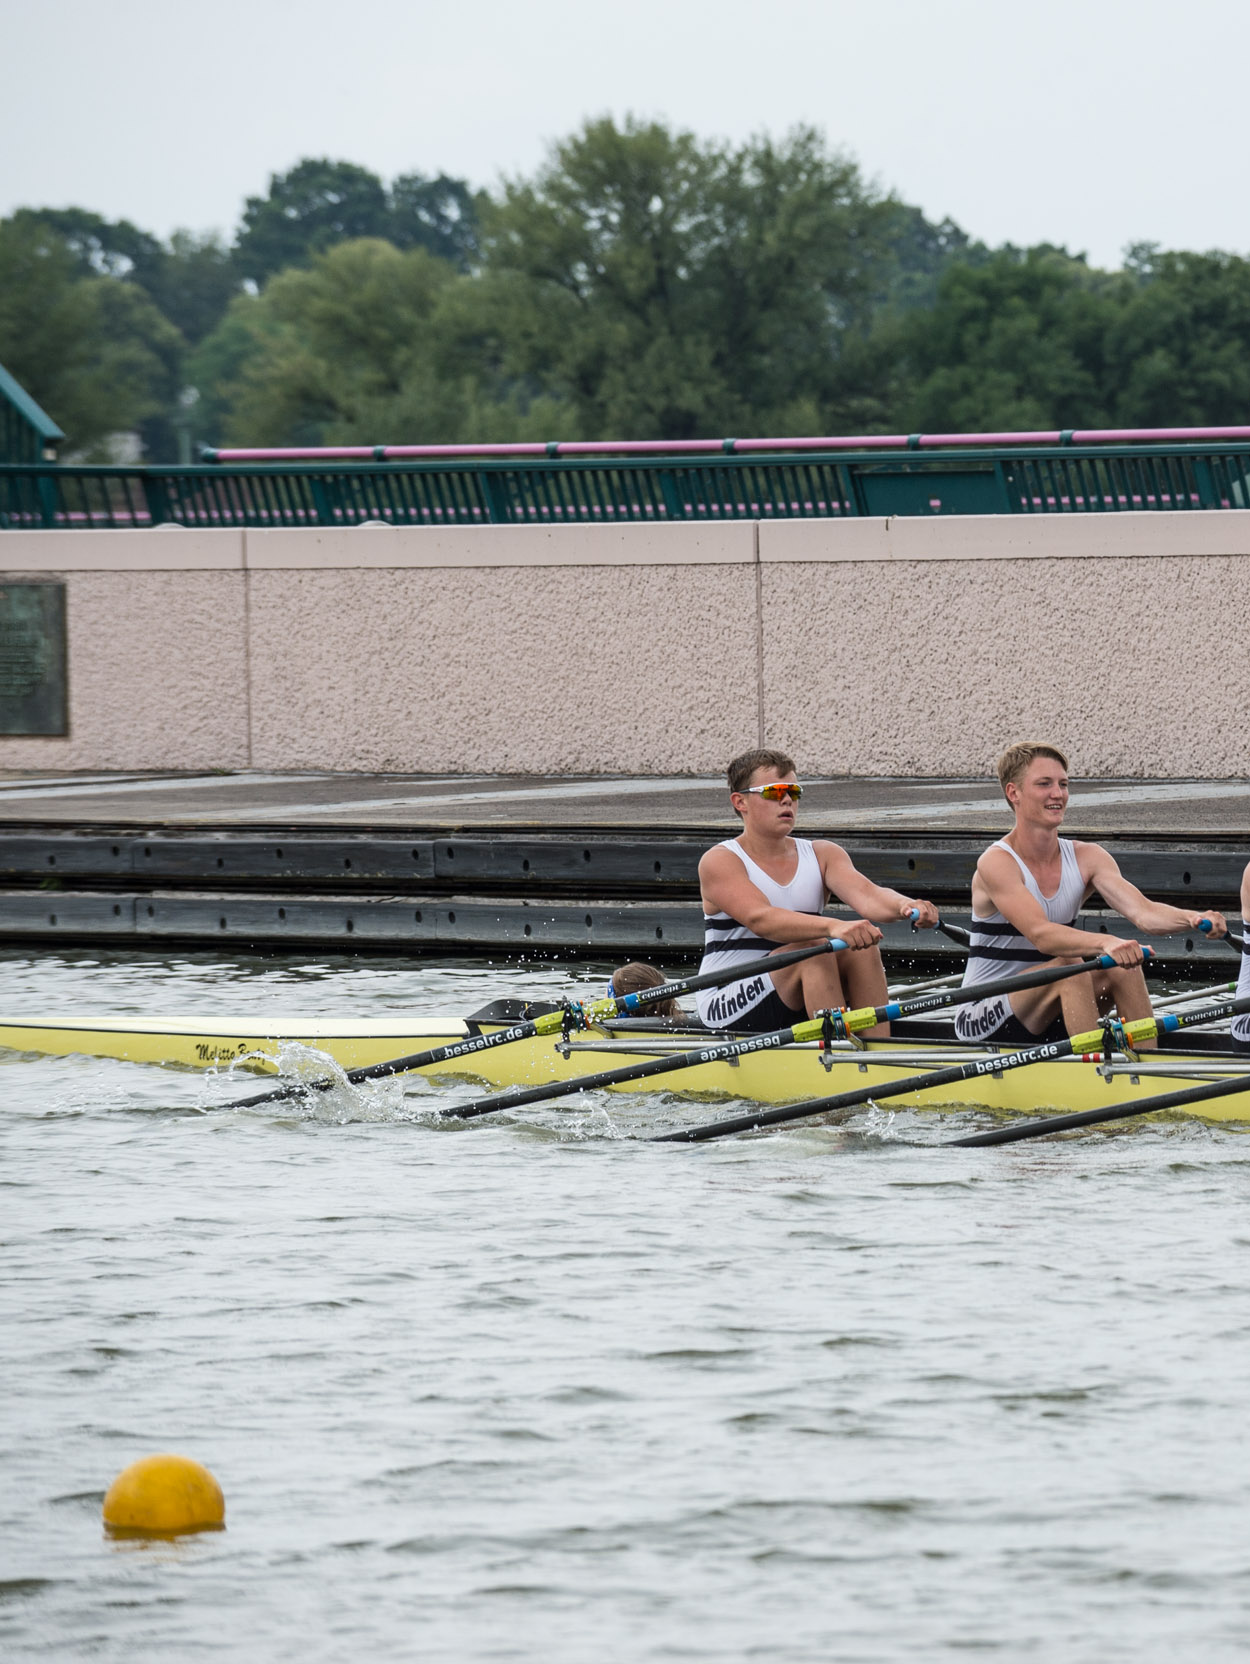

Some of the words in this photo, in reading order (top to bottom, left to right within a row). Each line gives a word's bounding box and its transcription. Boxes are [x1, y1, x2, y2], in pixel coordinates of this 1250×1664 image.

[641, 985, 679, 1000] concept
[707, 976, 765, 1021] Minden
[904, 997, 943, 1012] concept
[956, 1000, 1005, 1037] Minden
[1185, 1008, 1224, 1023] concept
[444, 1028, 523, 1057] besselrc.de
[700, 1035, 780, 1061] besselrc.de
[976, 1045, 1058, 1073] besselrc.de
